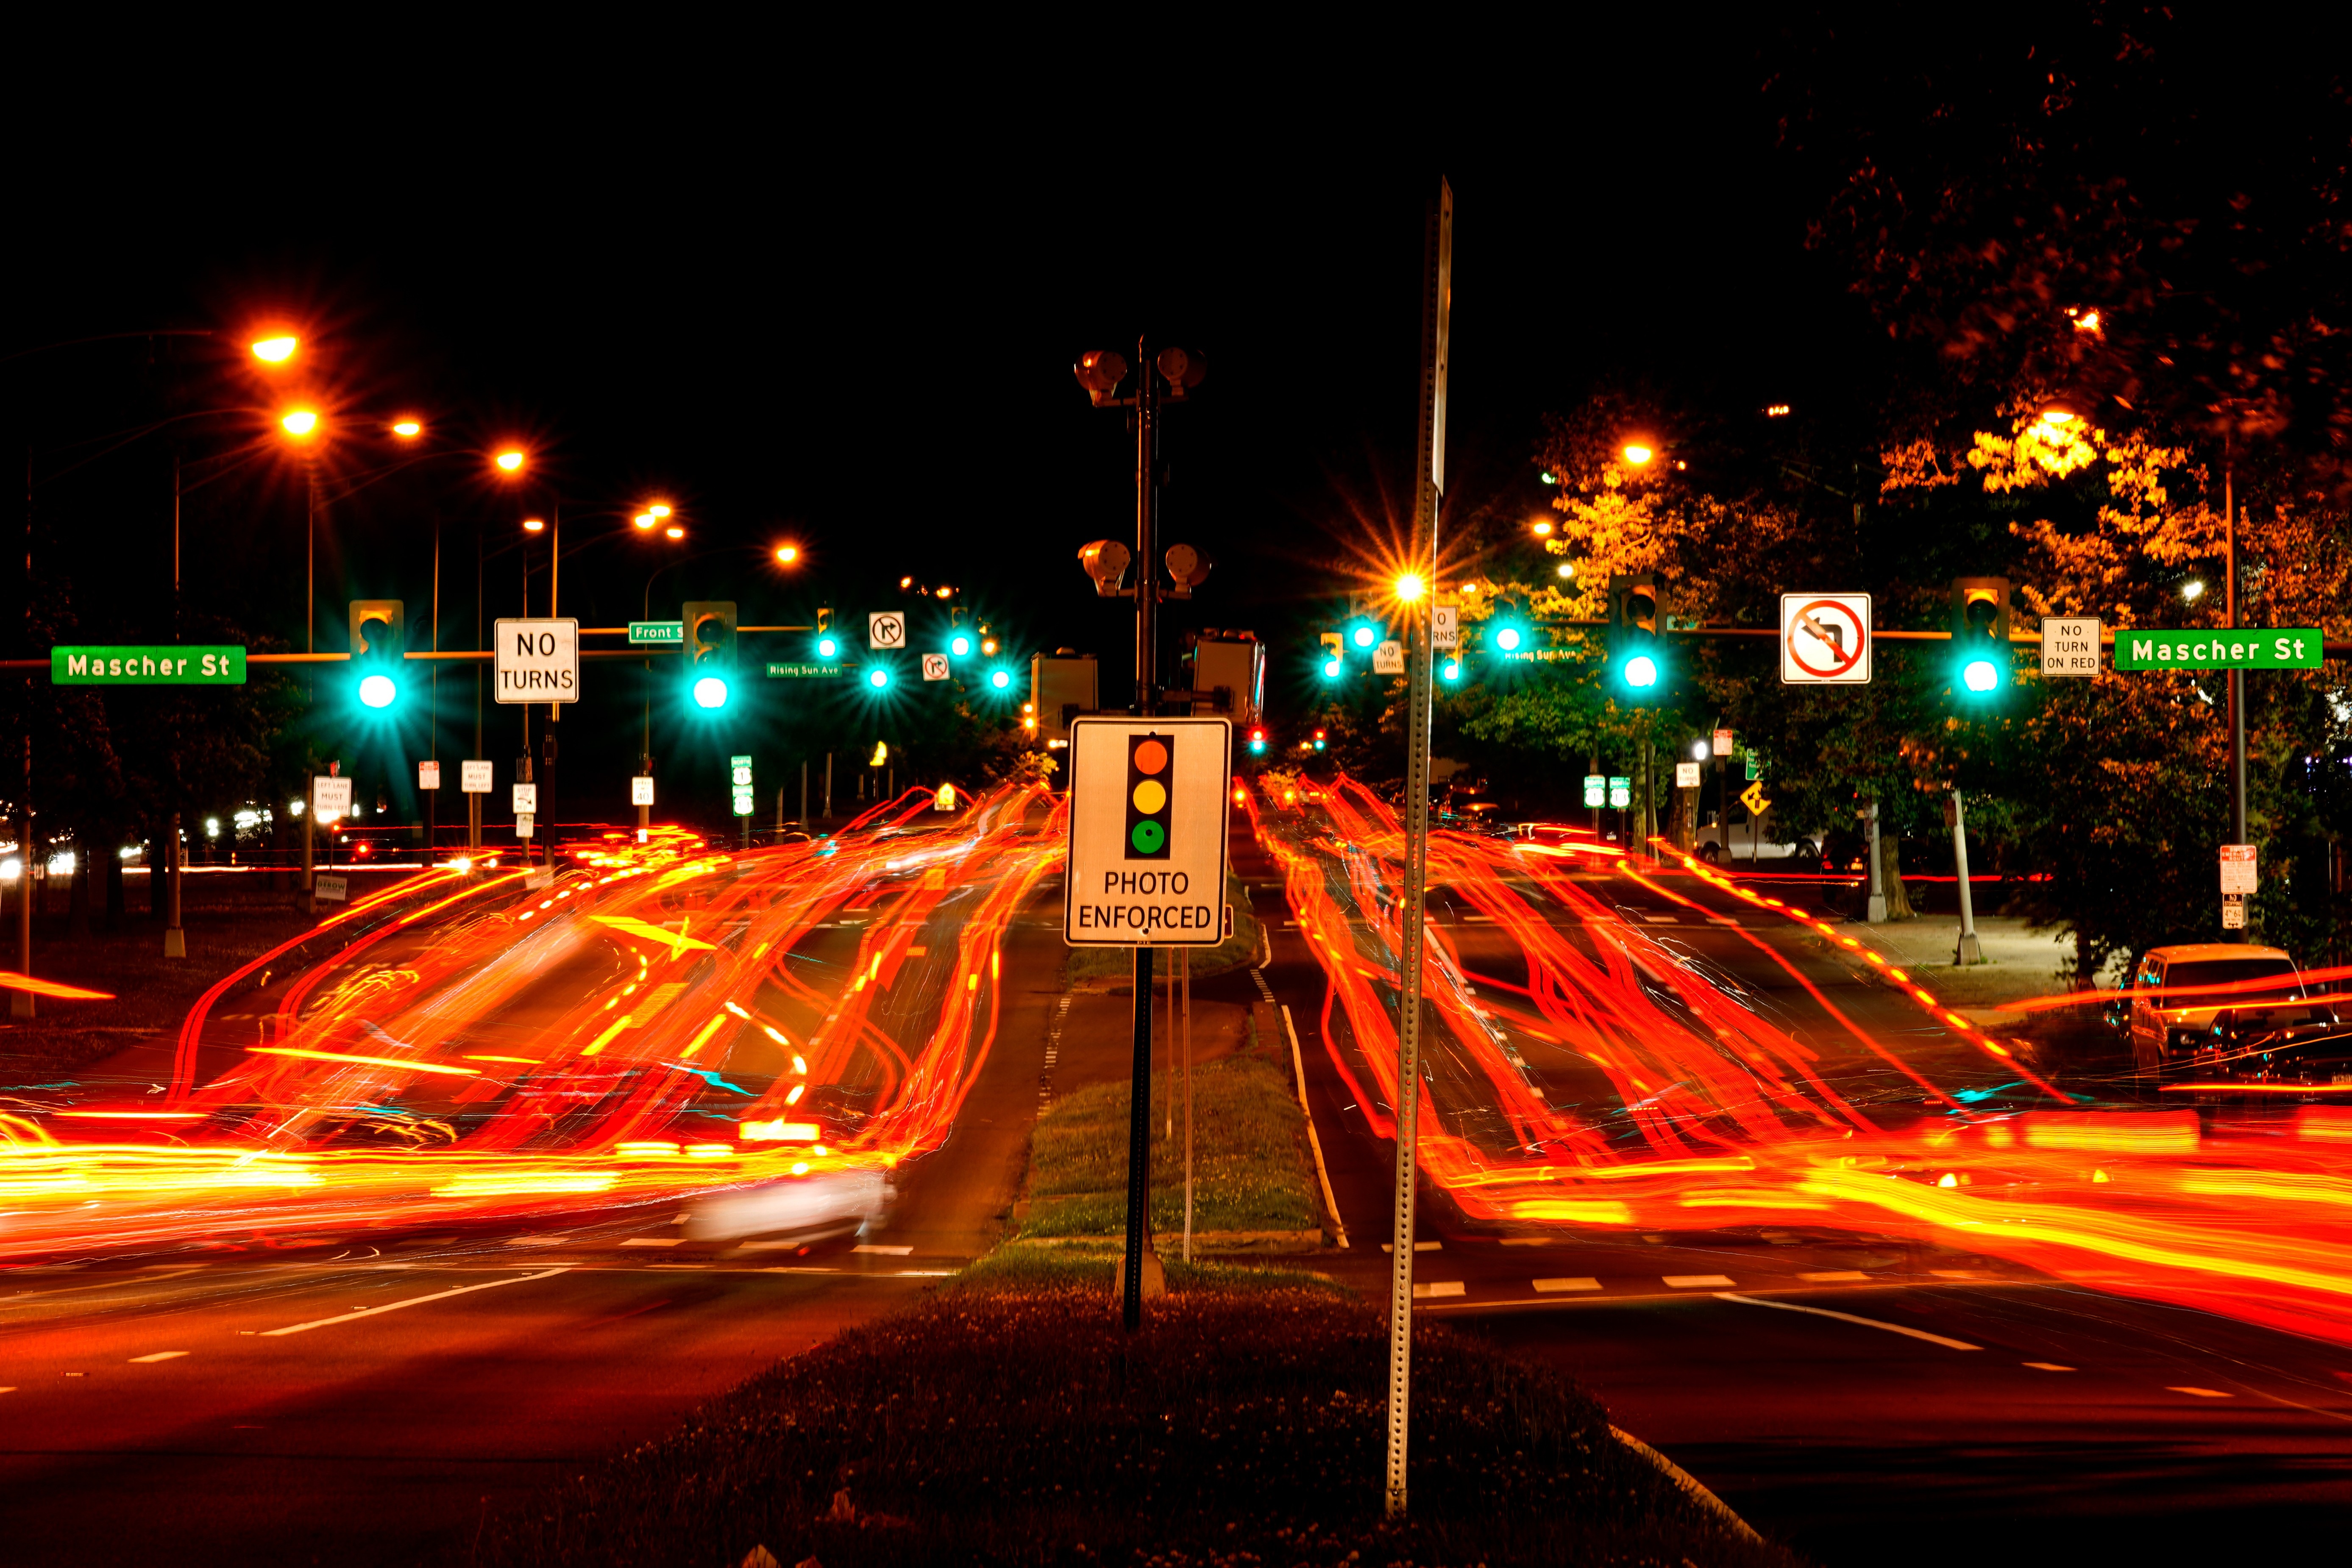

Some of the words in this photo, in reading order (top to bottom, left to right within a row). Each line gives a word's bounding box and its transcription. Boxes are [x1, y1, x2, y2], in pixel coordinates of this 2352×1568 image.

[636, 627, 671, 638] Front
[677, 627, 683, 638] S
[1433, 630, 1455, 642] RNS
[2061, 625, 2082, 636] NO
[517, 633, 555, 656] NO
[2055, 641, 2088, 652] TURN
[2132, 639, 2260, 661] Mascher
[2274, 638, 2305, 660] St
[1380, 646, 1394, 657] NO
[68, 654, 187, 676] Mascher
[201, 654, 229, 676] St
[1377, 661, 1402, 669] TURNS
[2047, 657, 2063, 668] ON
[2071, 657, 2095, 668] RED
[770, 664, 799, 677] Rising
[802, 665, 818, 675] Sun
[821, 666, 838, 674] Ave
[500, 670, 573, 689] TURNS
[637, 793, 649, 801] 40
[1105, 872, 1189, 895] PHOTO
[1079, 905, 1211, 929] ENFORCED
